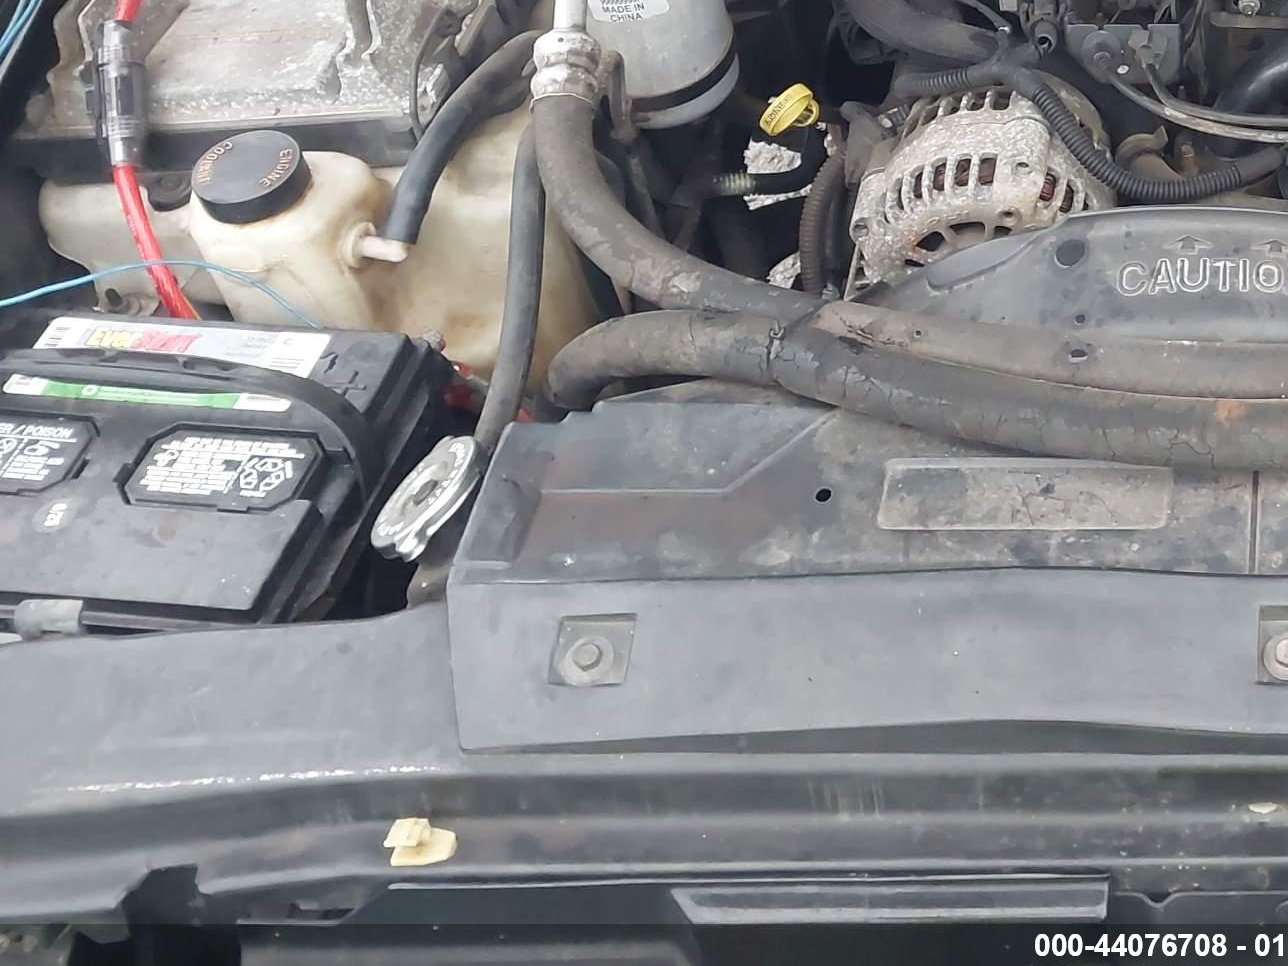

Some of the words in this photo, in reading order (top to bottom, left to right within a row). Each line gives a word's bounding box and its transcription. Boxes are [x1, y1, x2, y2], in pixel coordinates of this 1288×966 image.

[602, 5, 632, 13] MADE
[634, 3, 645, 11] IN
[610, 12, 643, 22] CHINA
[259, 148, 293, 187] ENGINE
